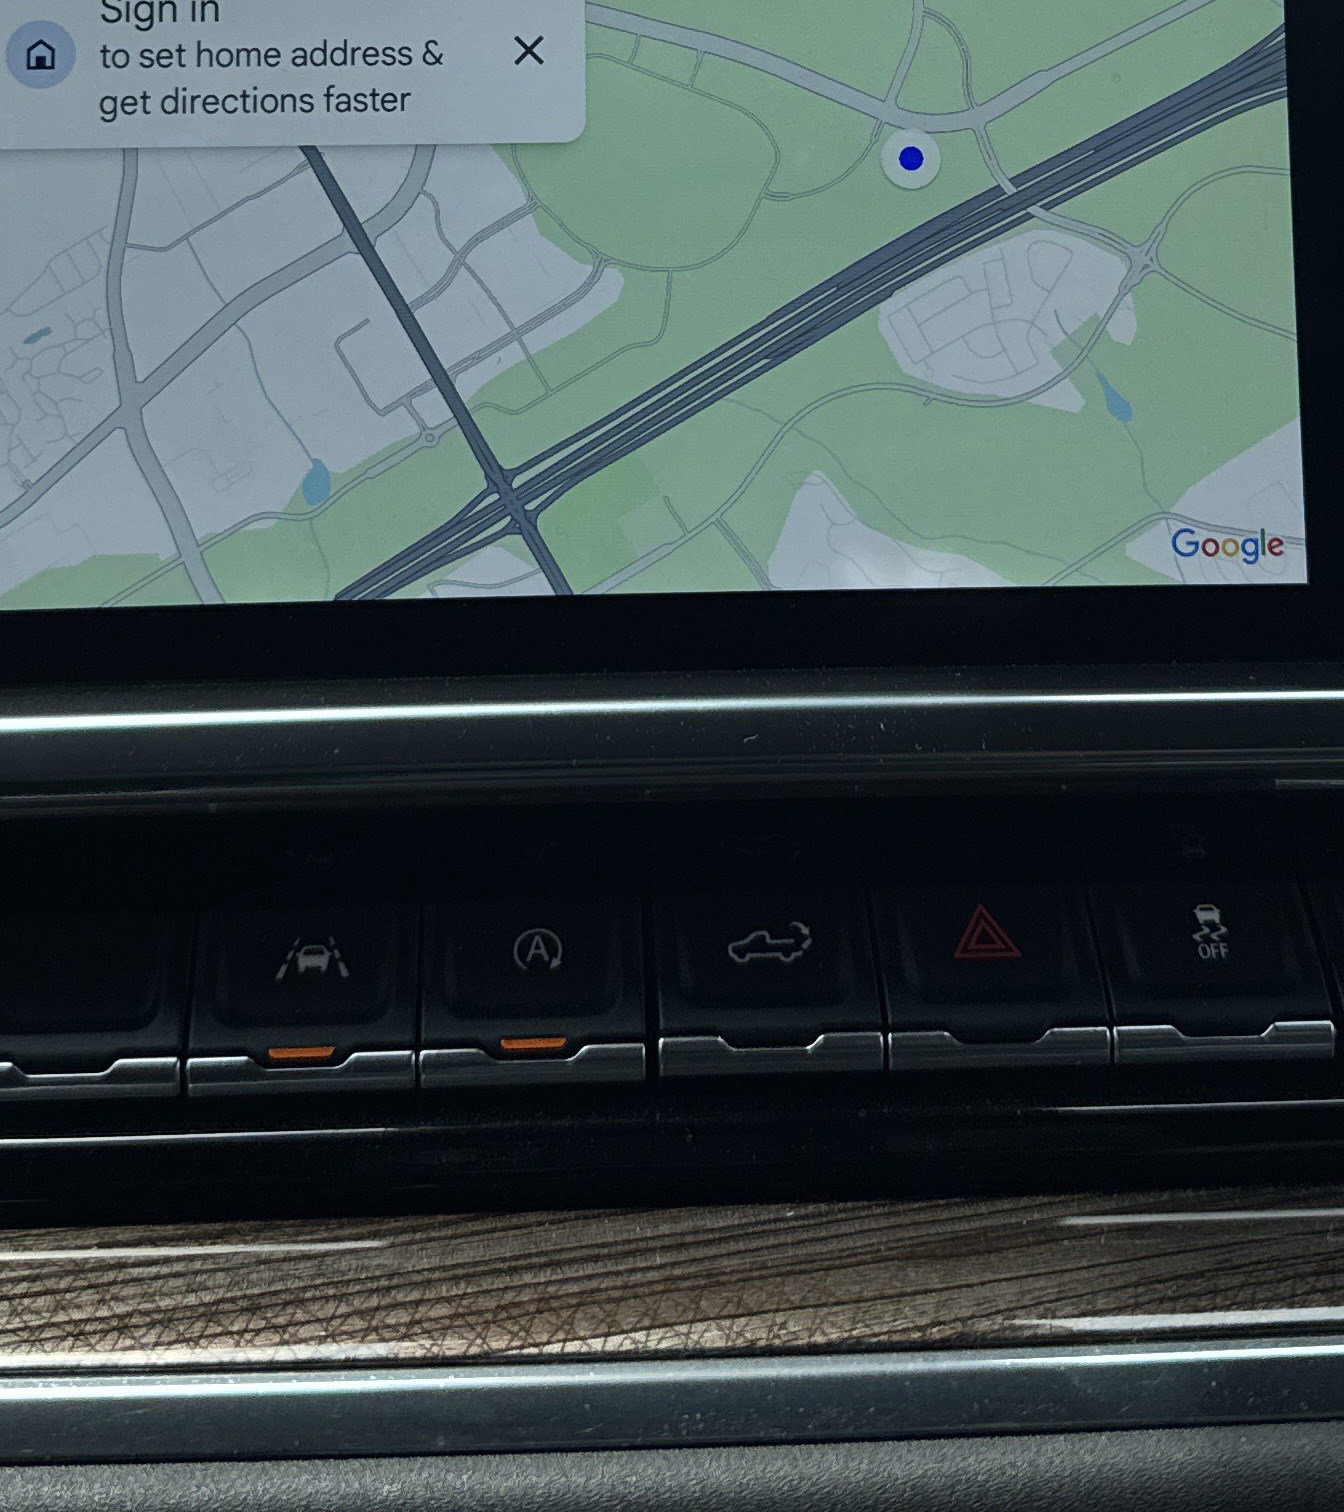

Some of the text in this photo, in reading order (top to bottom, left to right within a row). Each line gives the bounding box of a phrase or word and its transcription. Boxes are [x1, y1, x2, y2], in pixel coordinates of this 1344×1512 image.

[99, 38, 444, 69] to set home address &
[99, 84, 412, 124] get directions faster
[1171, 526, 1286, 566] Google
[1197, 942, 1230, 961] OFF
